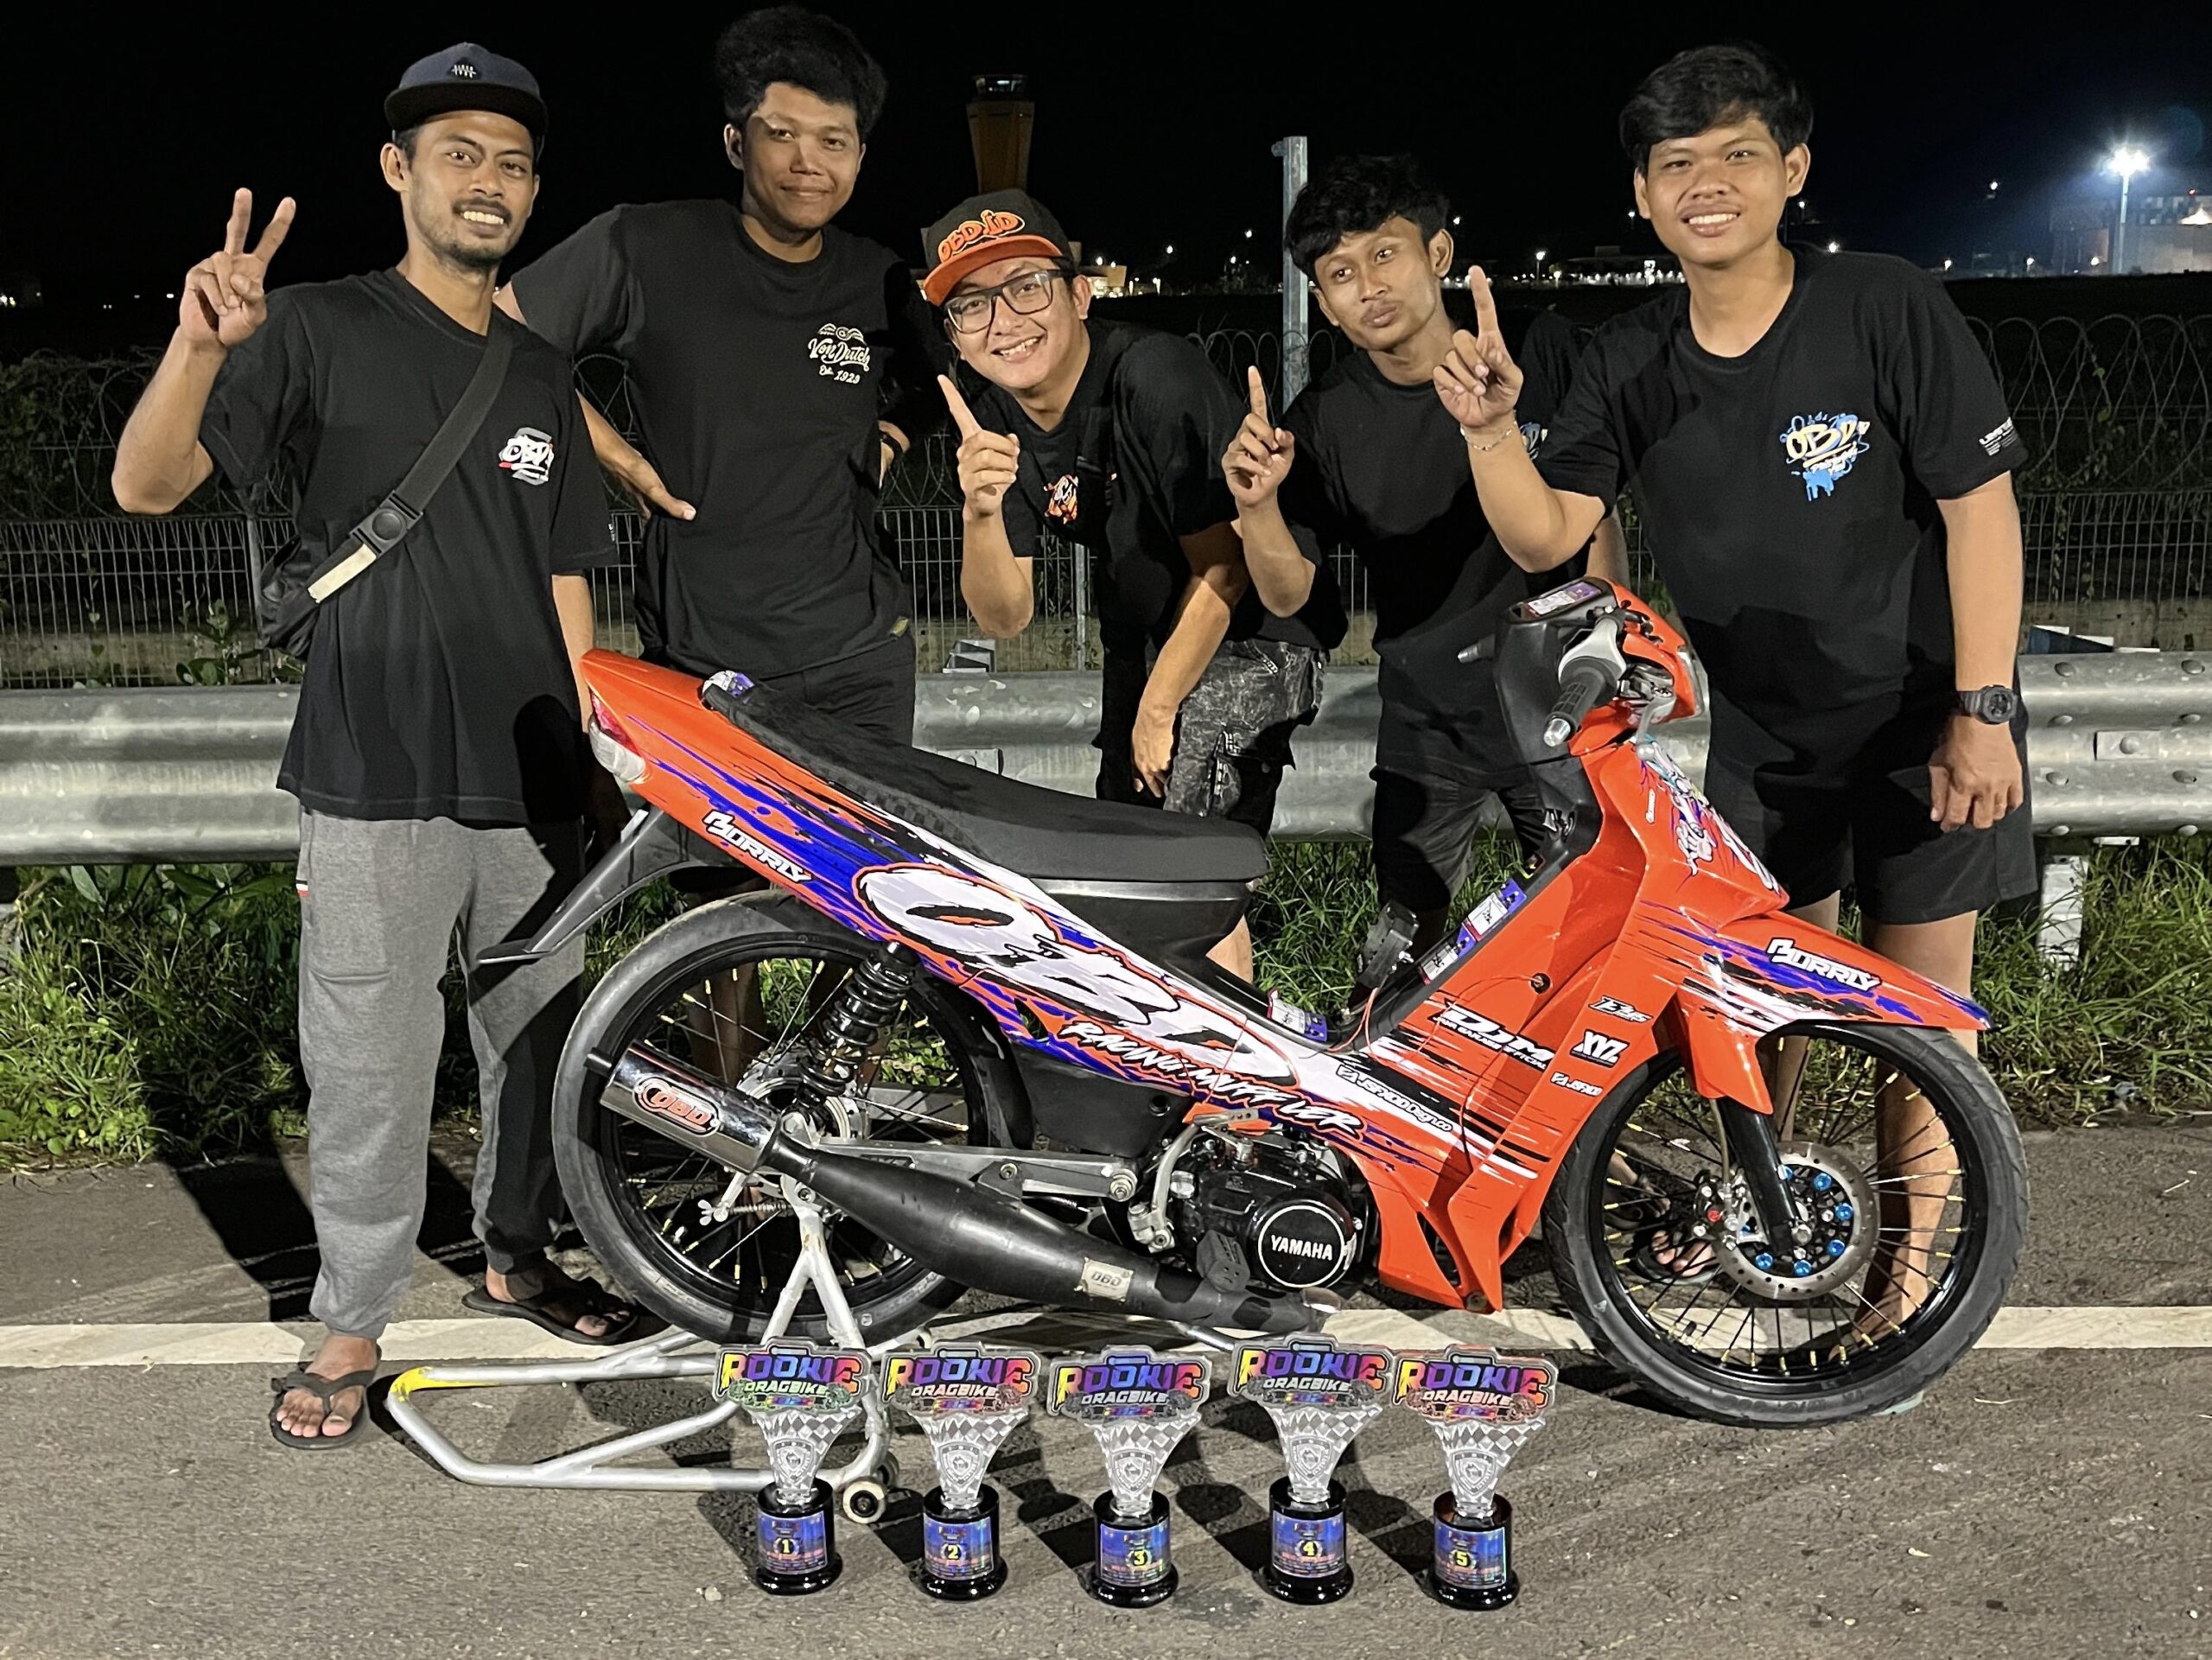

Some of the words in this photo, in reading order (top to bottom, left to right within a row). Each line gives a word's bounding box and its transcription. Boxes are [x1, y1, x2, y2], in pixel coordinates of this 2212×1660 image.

[808, 338, 836, 359] Von
[821, 341, 870, 372] Dutch
[834, 370, 861, 384] 1929
[1573, 1031, 1629, 1063] XYZ
[651, 1091, 711, 1125] OBD
[1178, 1068, 1366, 1135] MUFFLER
[1270, 1234, 1333, 1261] YAMAHA
[721, 1353, 860, 1393] ROOKIE
[887, 1358, 1031, 1396] ROOKIE
[1238, 1349, 1386, 1390] ROOKIE
[744, 1380, 828, 1396] DRAGBIKE
[911, 1383, 998, 1397] DRAGBIKE
[1057, 1364, 1201, 1404] ROOKIE
[1263, 1377, 1351, 1391] DRAGBIKE
[1397, 1360, 1548, 1405] ROOKIE
[1081, 1391, 1168, 1404] DRAGBIKE
[1422, 1390, 1512, 1405] DRAGBIKE
[782, 1539, 791, 1554] 1
[947, 1544, 959, 1560] 2
[1302, 1541, 1315, 1556] 4
[1133, 1550, 1146, 1566] 3
[1455, 1551, 1468, 1567] 5
